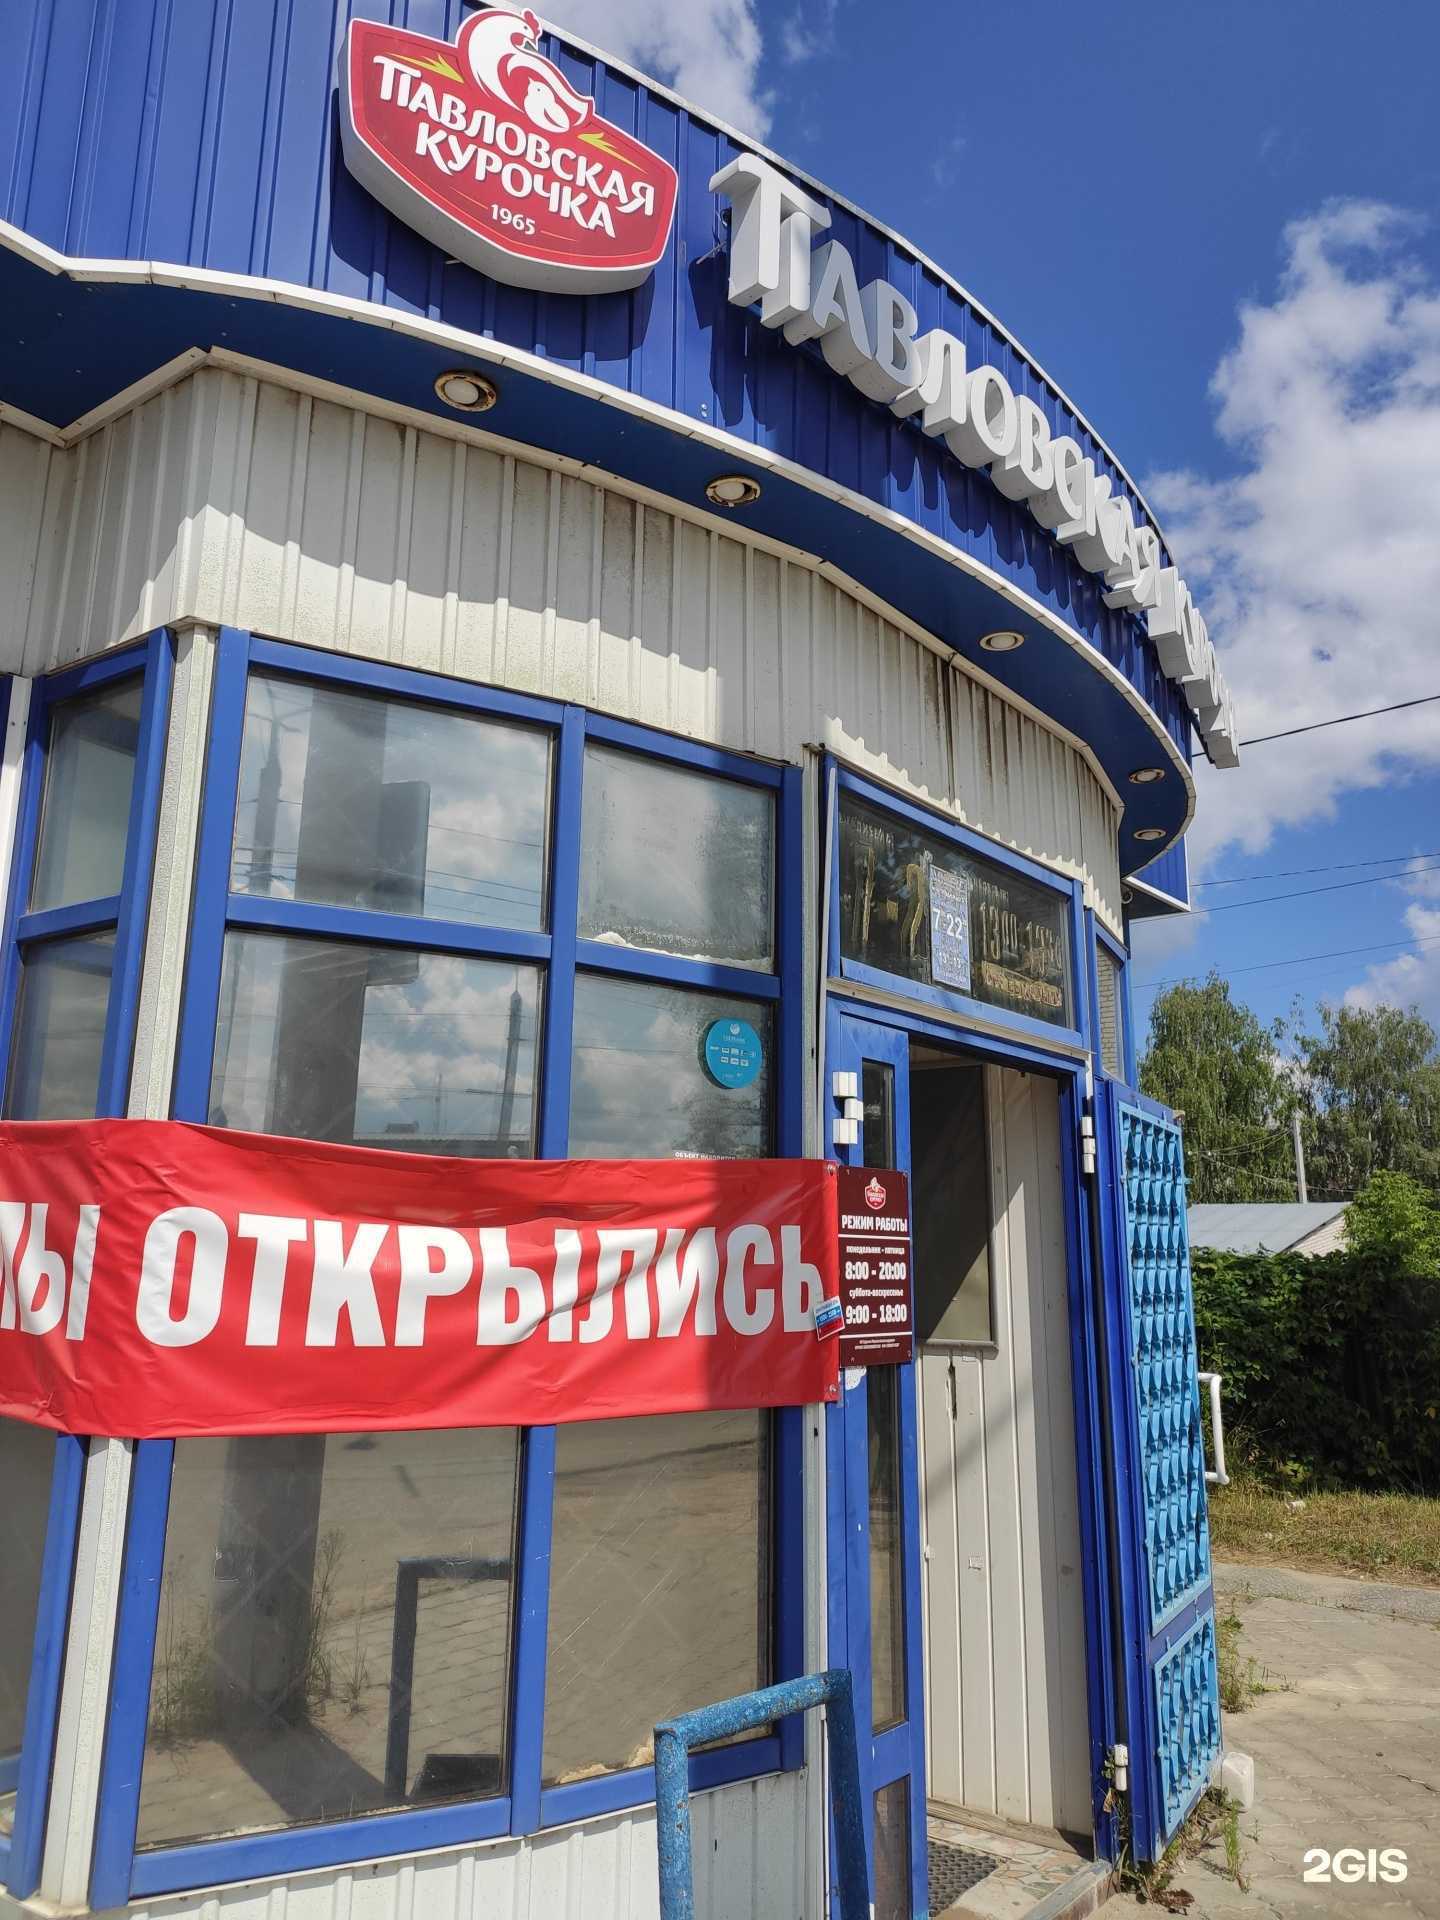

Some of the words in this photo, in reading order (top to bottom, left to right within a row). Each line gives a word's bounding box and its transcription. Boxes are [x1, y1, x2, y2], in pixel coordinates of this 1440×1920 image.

[373, 55, 655, 217] ПАВЛОВСКАЯ
[415, 122, 616, 239] КУРОЧКА
[490, 203, 536, 236] 1965
[709, 152, 1161, 613] ПАВЛОВСКАЯ
[841, 1214, 874, 1230] РЕЖИМ
[875, 1216, 908, 1232] РАБОТЫ
[136, 1206, 824, 1348] ОТКРЫЛИСЬ
[845, 1261, 869, 1280] 8:00
[879, 1261, 907, 1280] 20:00
[845, 1304, 869, 1324] 9:00
[879, 1303, 907, 1323] 18:00
